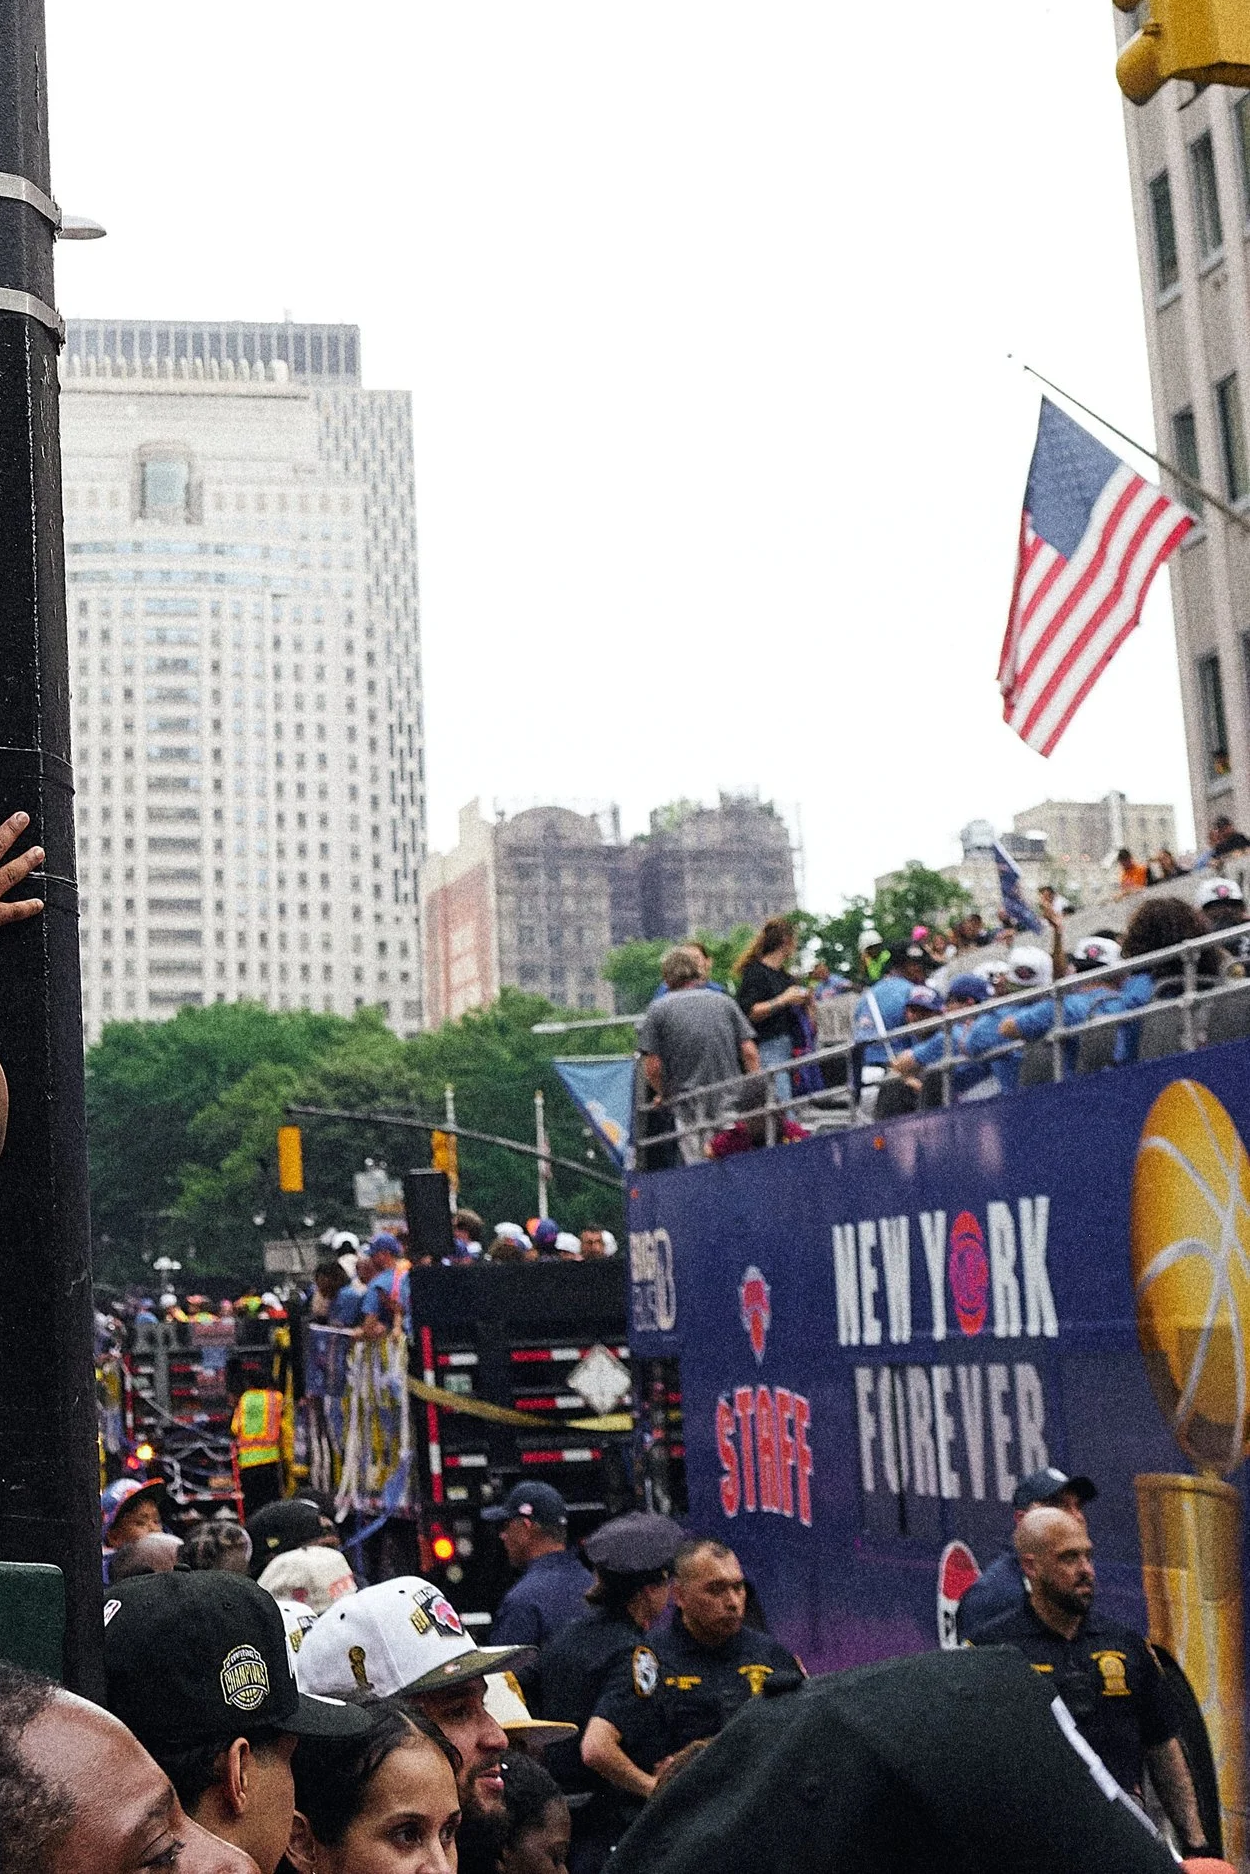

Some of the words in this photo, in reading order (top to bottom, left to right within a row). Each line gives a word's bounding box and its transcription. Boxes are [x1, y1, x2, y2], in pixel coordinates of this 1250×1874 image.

[831, 1215, 912, 1346] NEW
[918, 1196, 1059, 1342] YORK
[715, 1385, 813, 1527] STAFF
[855, 1362, 1050, 1502] FOREVER
